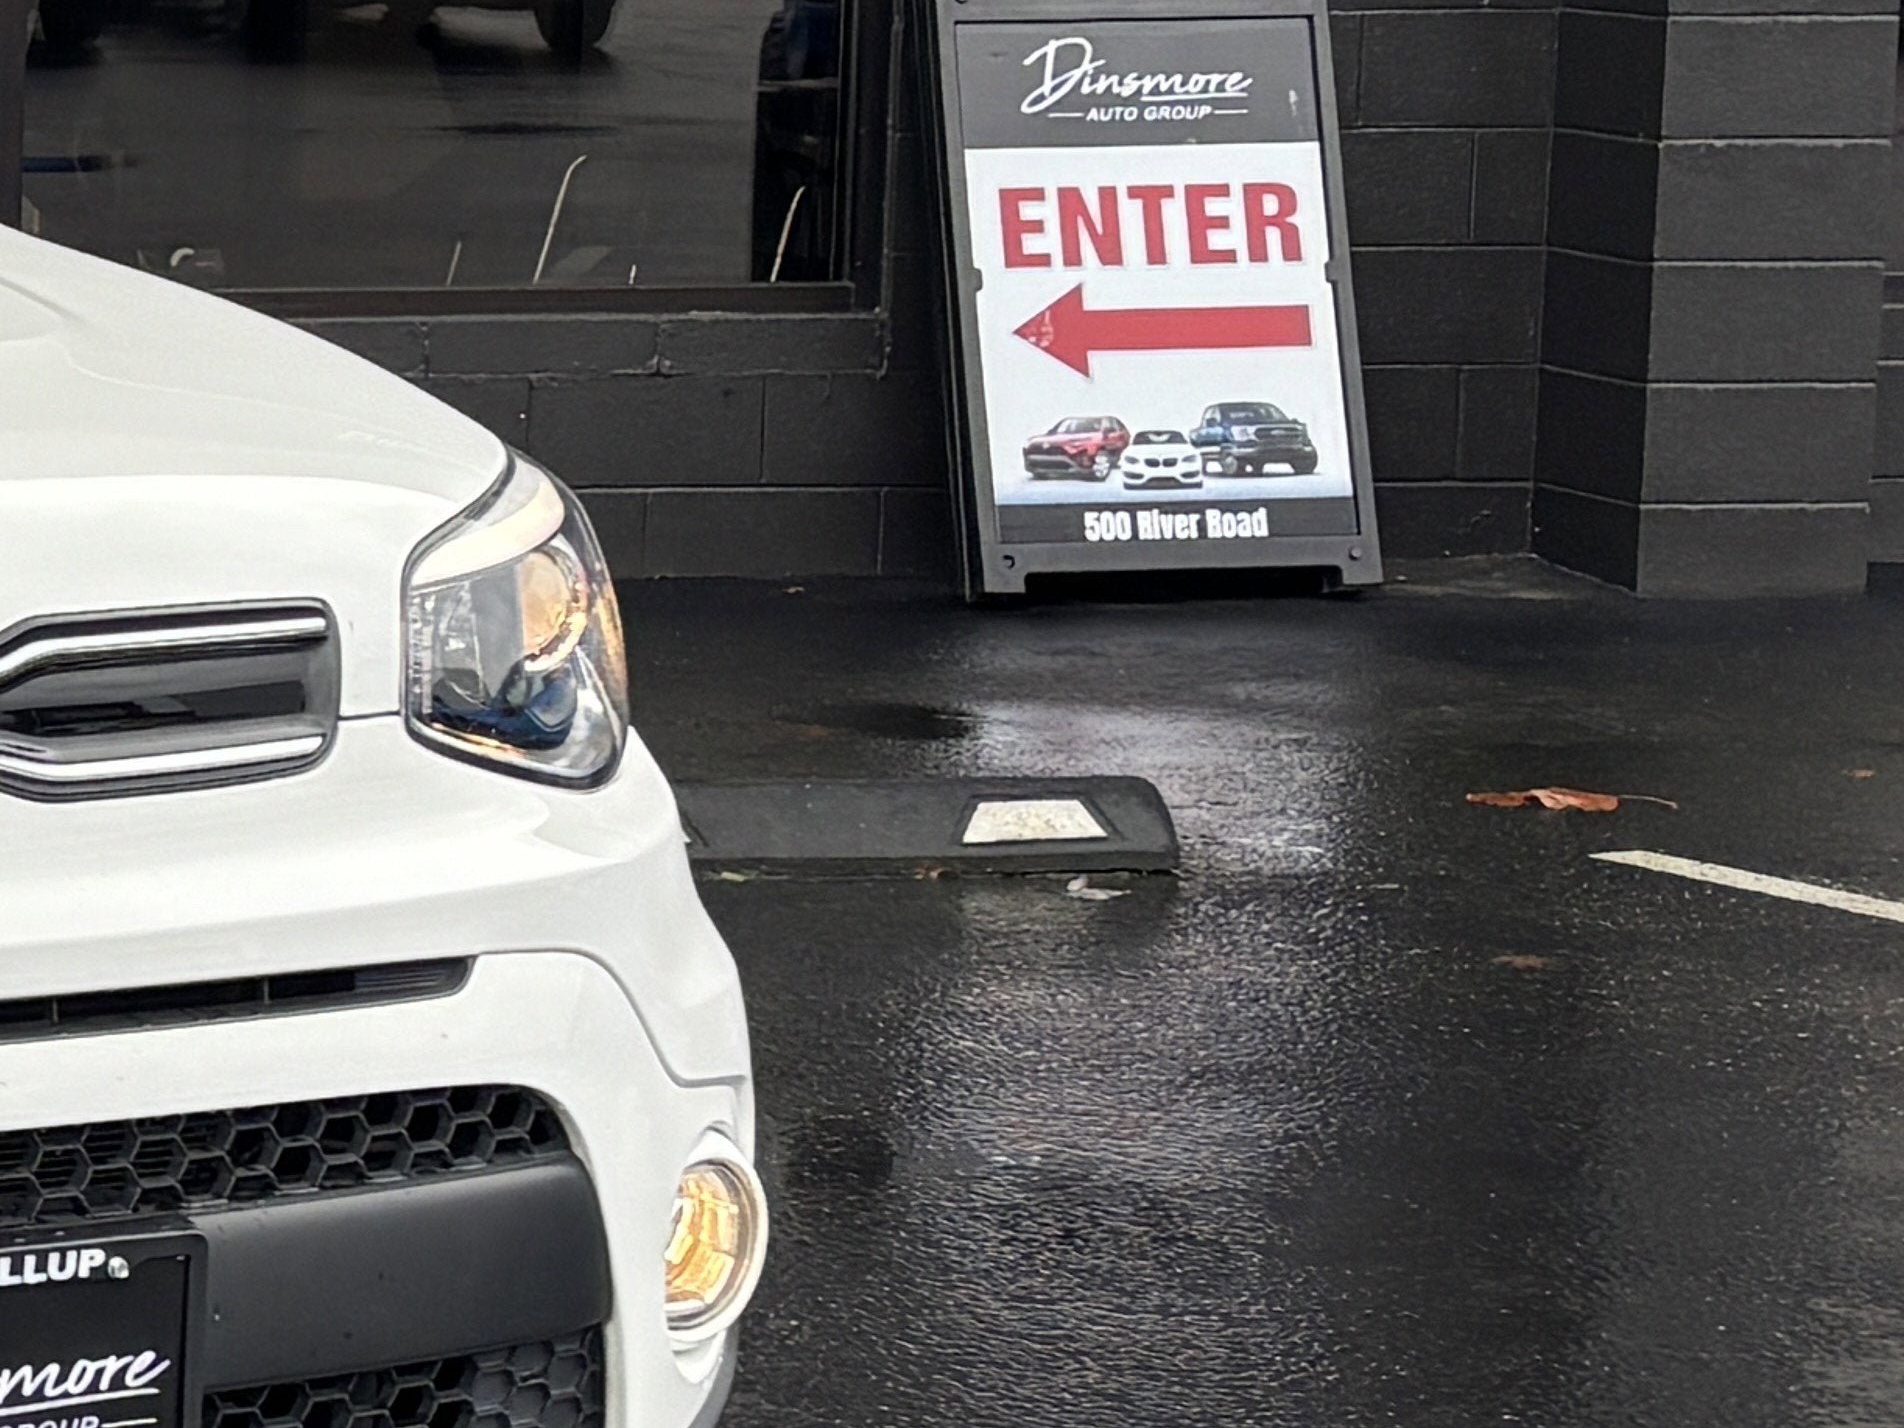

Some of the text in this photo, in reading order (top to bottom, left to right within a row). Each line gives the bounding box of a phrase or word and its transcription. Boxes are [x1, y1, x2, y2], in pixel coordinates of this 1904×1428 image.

[1020, 36, 1254, 114] Dinsmore
[1085, 105, 1213, 122] AUTO GROUP
[997, 181, 1304, 269] ENTER
[1083, 506, 1270, 542] 500 River Road
